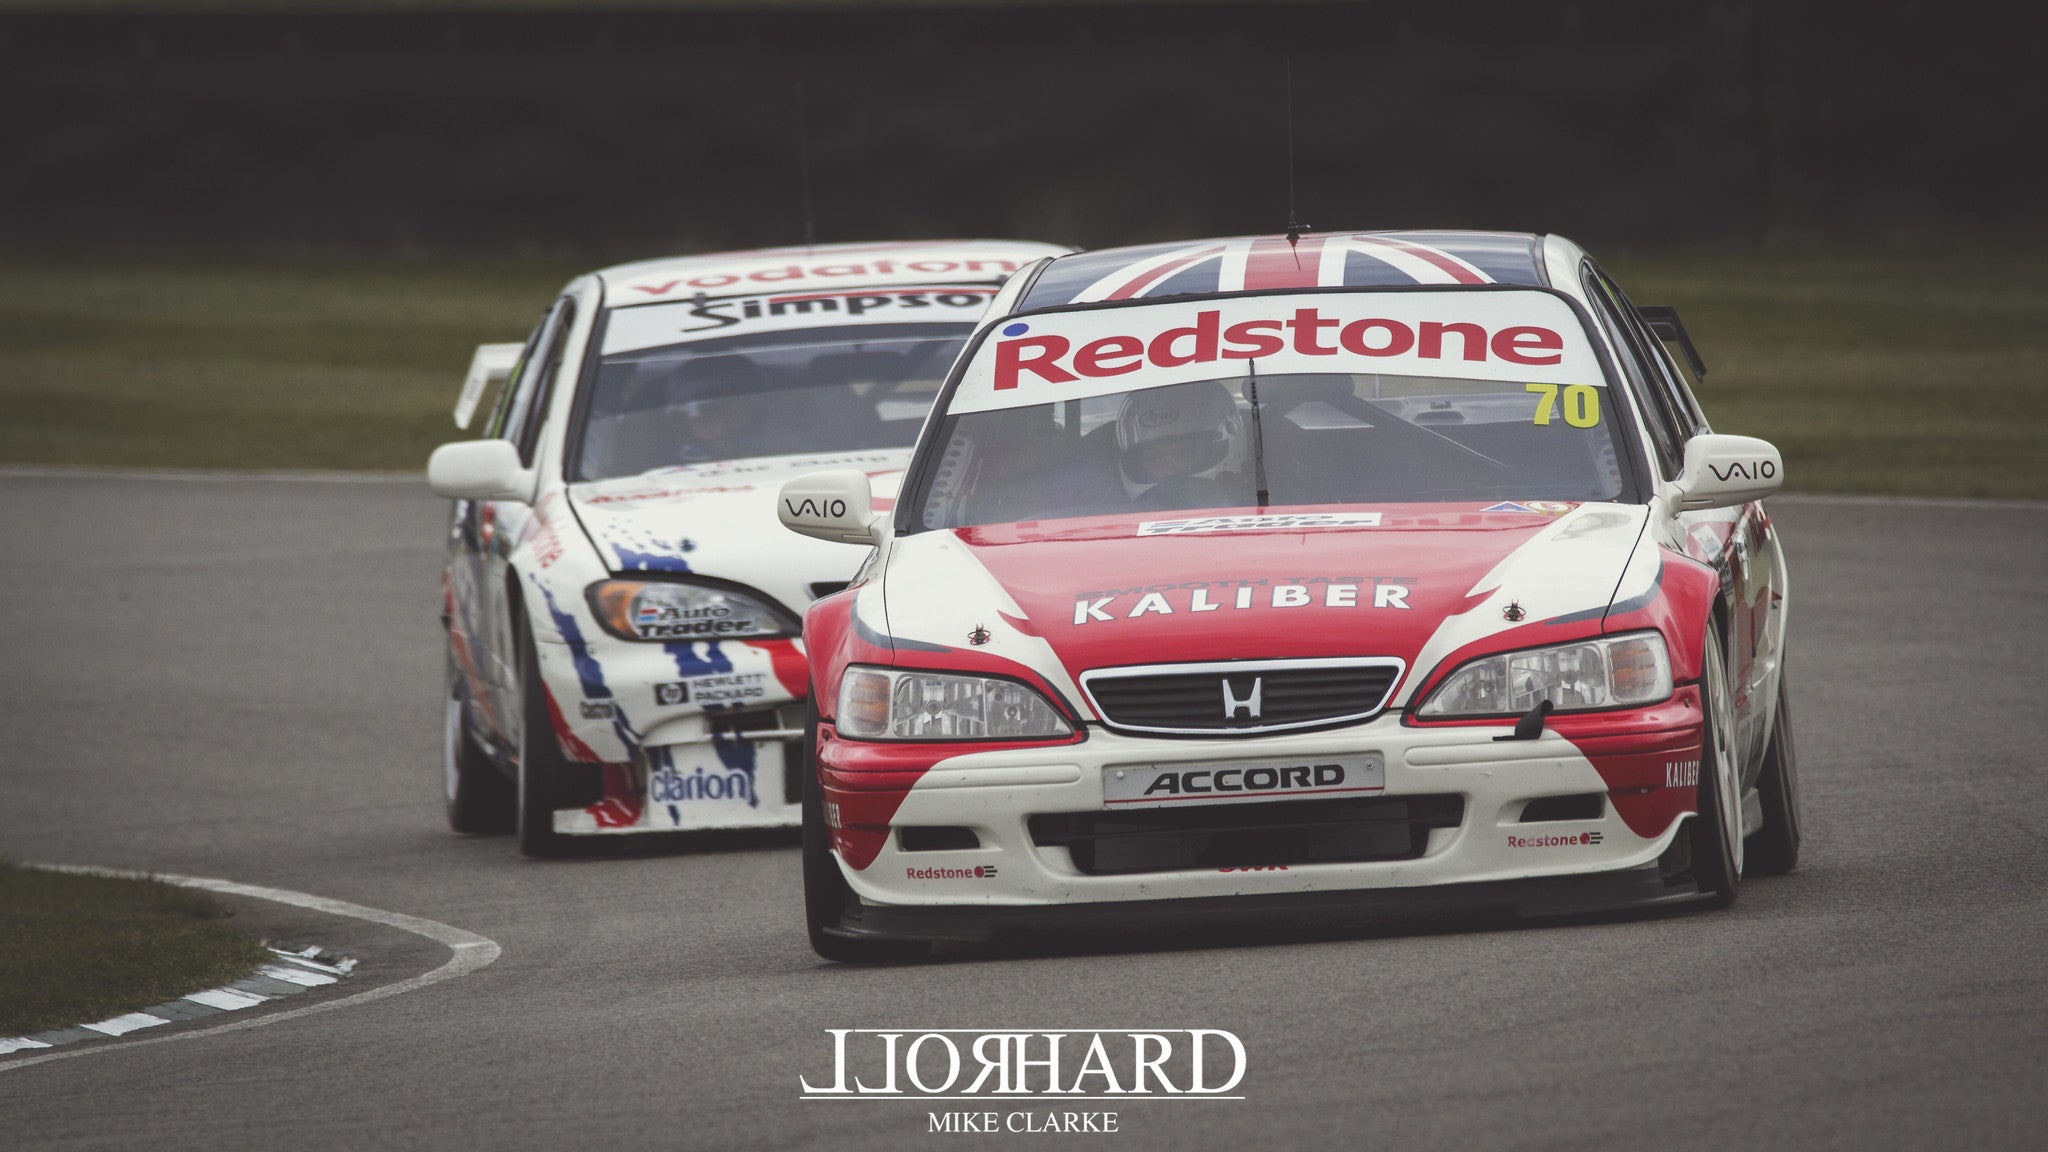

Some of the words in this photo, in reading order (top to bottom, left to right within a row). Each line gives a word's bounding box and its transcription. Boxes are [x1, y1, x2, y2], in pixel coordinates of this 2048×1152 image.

[634, 257, 1028, 296] vodafon
[681, 291, 997, 333] Simpso
[993, 308, 1563, 391] Redstone
[1525, 384, 1600, 429] 70
[1708, 460, 1776, 482] VAIO
[785, 498, 847, 518] VAIO
[1076, 577, 1268, 599] SMOOTH
[1281, 574, 1419, 586] TASTE
[658, 606, 731, 620] Auto
[1072, 583, 1414, 626] KALIBER
[638, 618, 752, 638] Trader
[693, 674, 765, 689] HEWLETT
[694, 688, 763, 701] PACKARD
[651, 766, 751, 802] clarion
[1143, 763, 1346, 796] ACCORD
[1507, 833, 1578, 848] Redstone
[906, 865, 973, 880] Redstone
